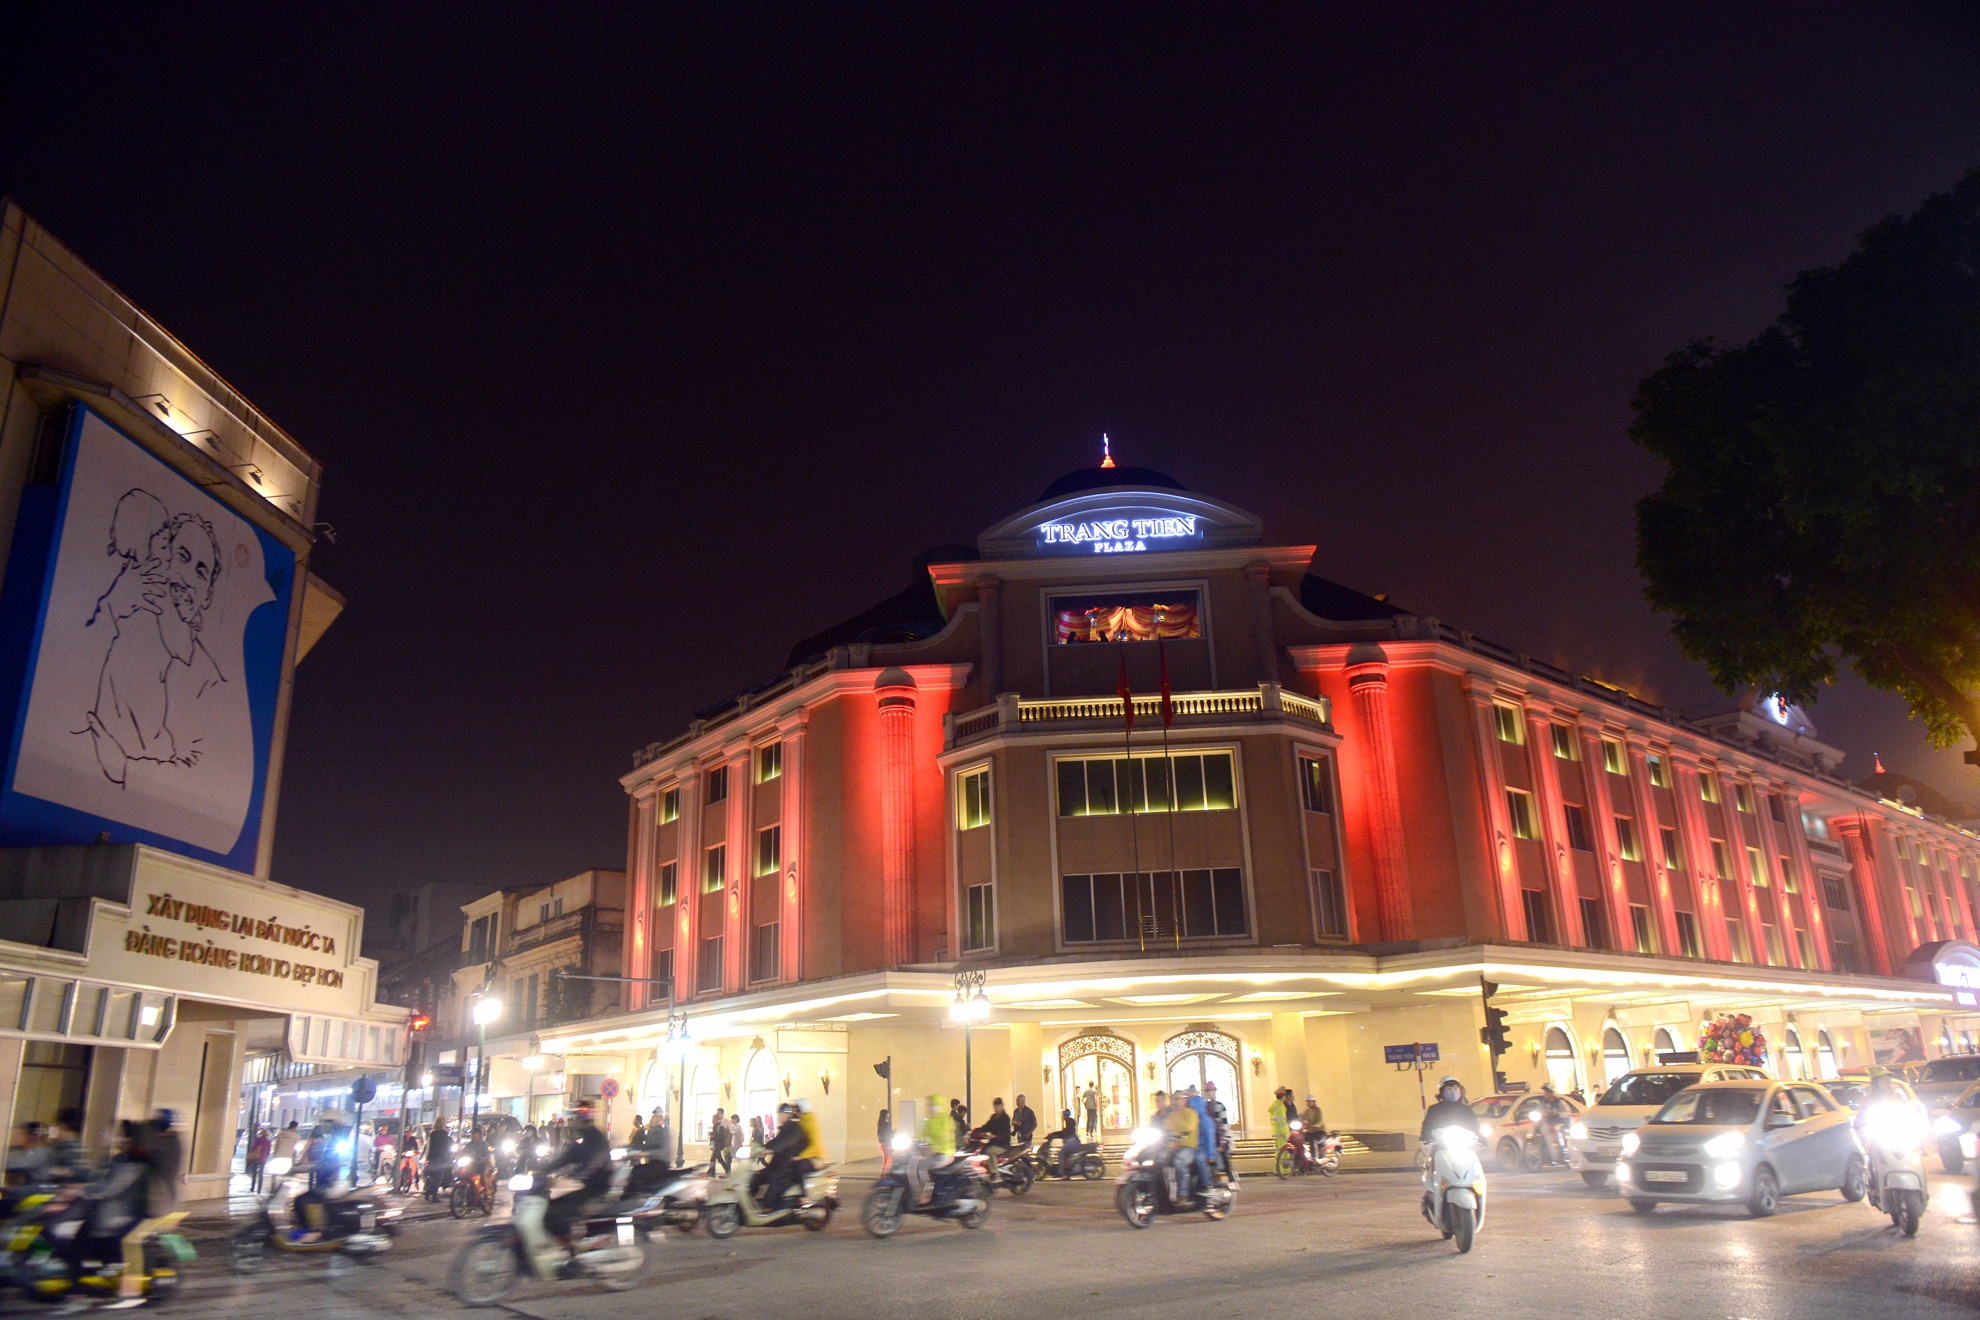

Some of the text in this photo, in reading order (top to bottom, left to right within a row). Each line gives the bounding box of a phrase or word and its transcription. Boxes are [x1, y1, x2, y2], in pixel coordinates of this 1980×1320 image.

[1041, 517, 1196, 543] TRANG TIEN
[1094, 540, 1146, 553] PLAZA
[147, 893, 336, 956] XÂY DỰNG LẠI ĐẤT NƯỚC TA
[125, 925, 345, 989] ĐÀNG HOÀNG HƠN TO ĐẸP HƠN
